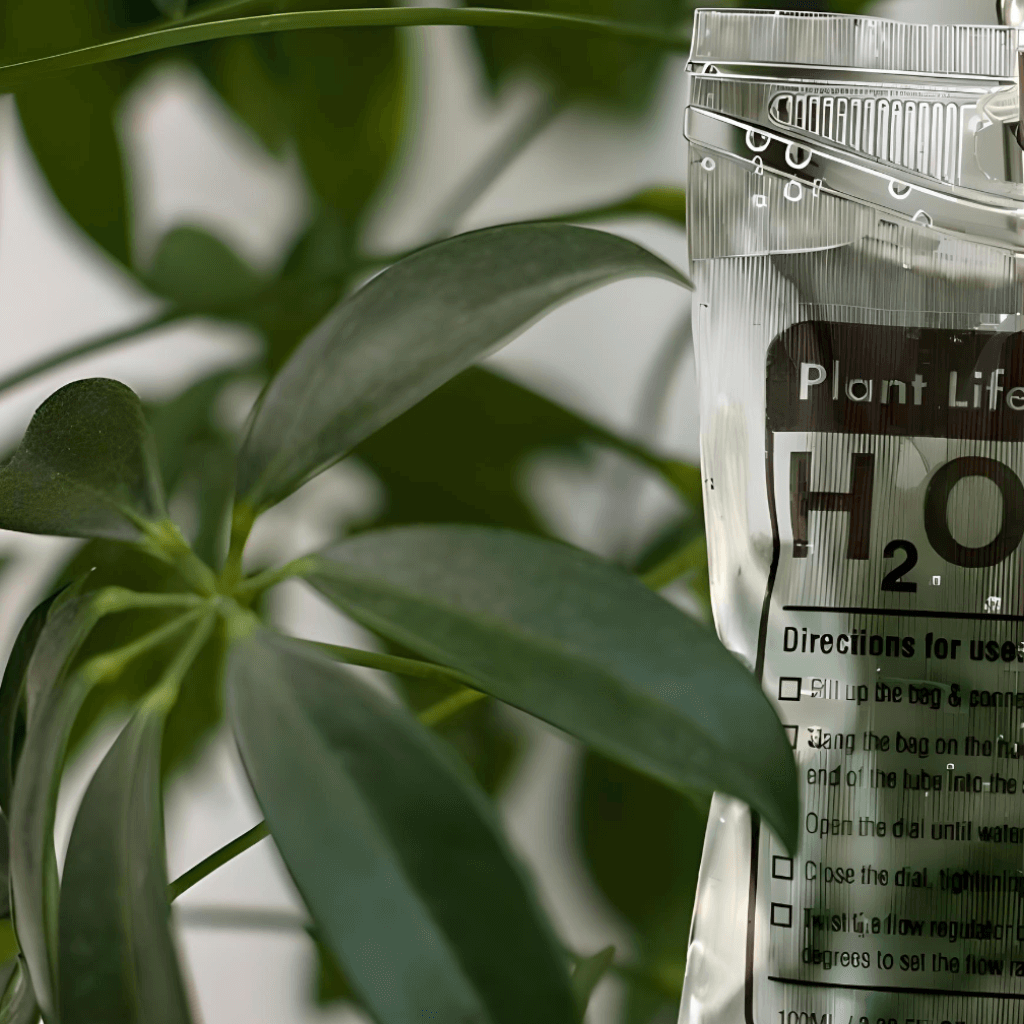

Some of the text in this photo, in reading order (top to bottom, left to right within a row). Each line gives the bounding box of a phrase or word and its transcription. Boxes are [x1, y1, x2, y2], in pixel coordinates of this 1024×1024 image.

[799, 359, 928, 405] Plant
[783, 626, 915, 658] Directions
[925, 631, 961, 659] for
[846, 683, 869, 705] up
[875, 682, 902, 703] the
[908, 684, 941, 709] bag
[948, 683, 962, 707] &
[863, 731, 889, 752] the
[896, 731, 929, 758] bag
[935, 737, 958, 756] on
[807, 765, 841, 786] end
[990, 772, 1017, 795] the
[806, 811, 853, 839] Open
[859, 816, 886, 837] the
[805, 860, 855, 884] Close
[861, 864, 888, 886] the
[877, 951, 894, 970] to
[900, 952, 925, 972] set
[932, 952, 959, 974] the
[965, 953, 1003, 975] flow
